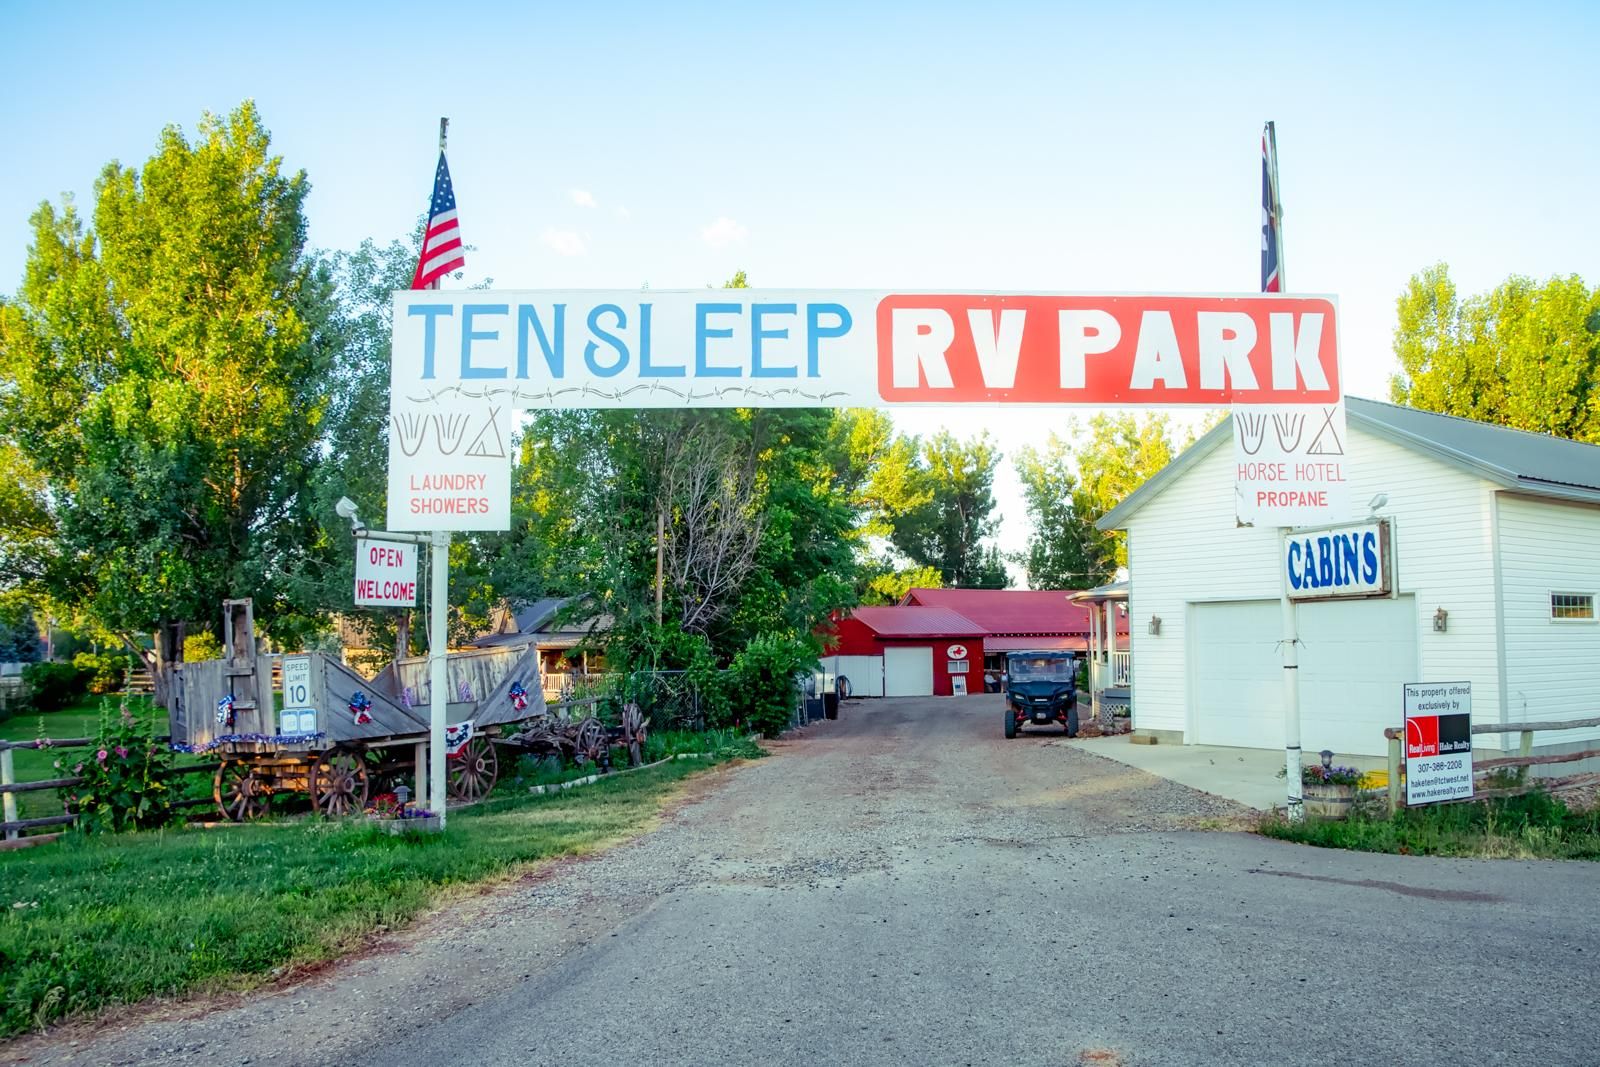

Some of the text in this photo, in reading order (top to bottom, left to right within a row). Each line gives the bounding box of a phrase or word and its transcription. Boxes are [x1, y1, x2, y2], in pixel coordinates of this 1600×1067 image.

[408, 303, 853, 379] TEN SLEEP
[892, 308, 1330, 390] RV PARK
[1237, 463, 1347, 481] HORSE HOTEL
[410, 474, 487, 490] LAUNDRY
[410, 498, 489, 514] SHOWERS
[1257, 491, 1328, 507] PROPANE
[370, 547, 403, 567] OPEN
[1288, 531, 1378, 590] CABINS
[357, 579, 415, 600] WELCOME
[286, 662, 309, 672] SPEED
[289, 673, 306, 682] LIMIT
[290, 685, 306, 703] 10
[1406, 686, 1470, 699] This property offered
[1418, 700, 1460, 710] exclusively by
[1454, 740, 1470, 751] Realty
[1412, 785, 1470, 799] www.hakerealty.com
